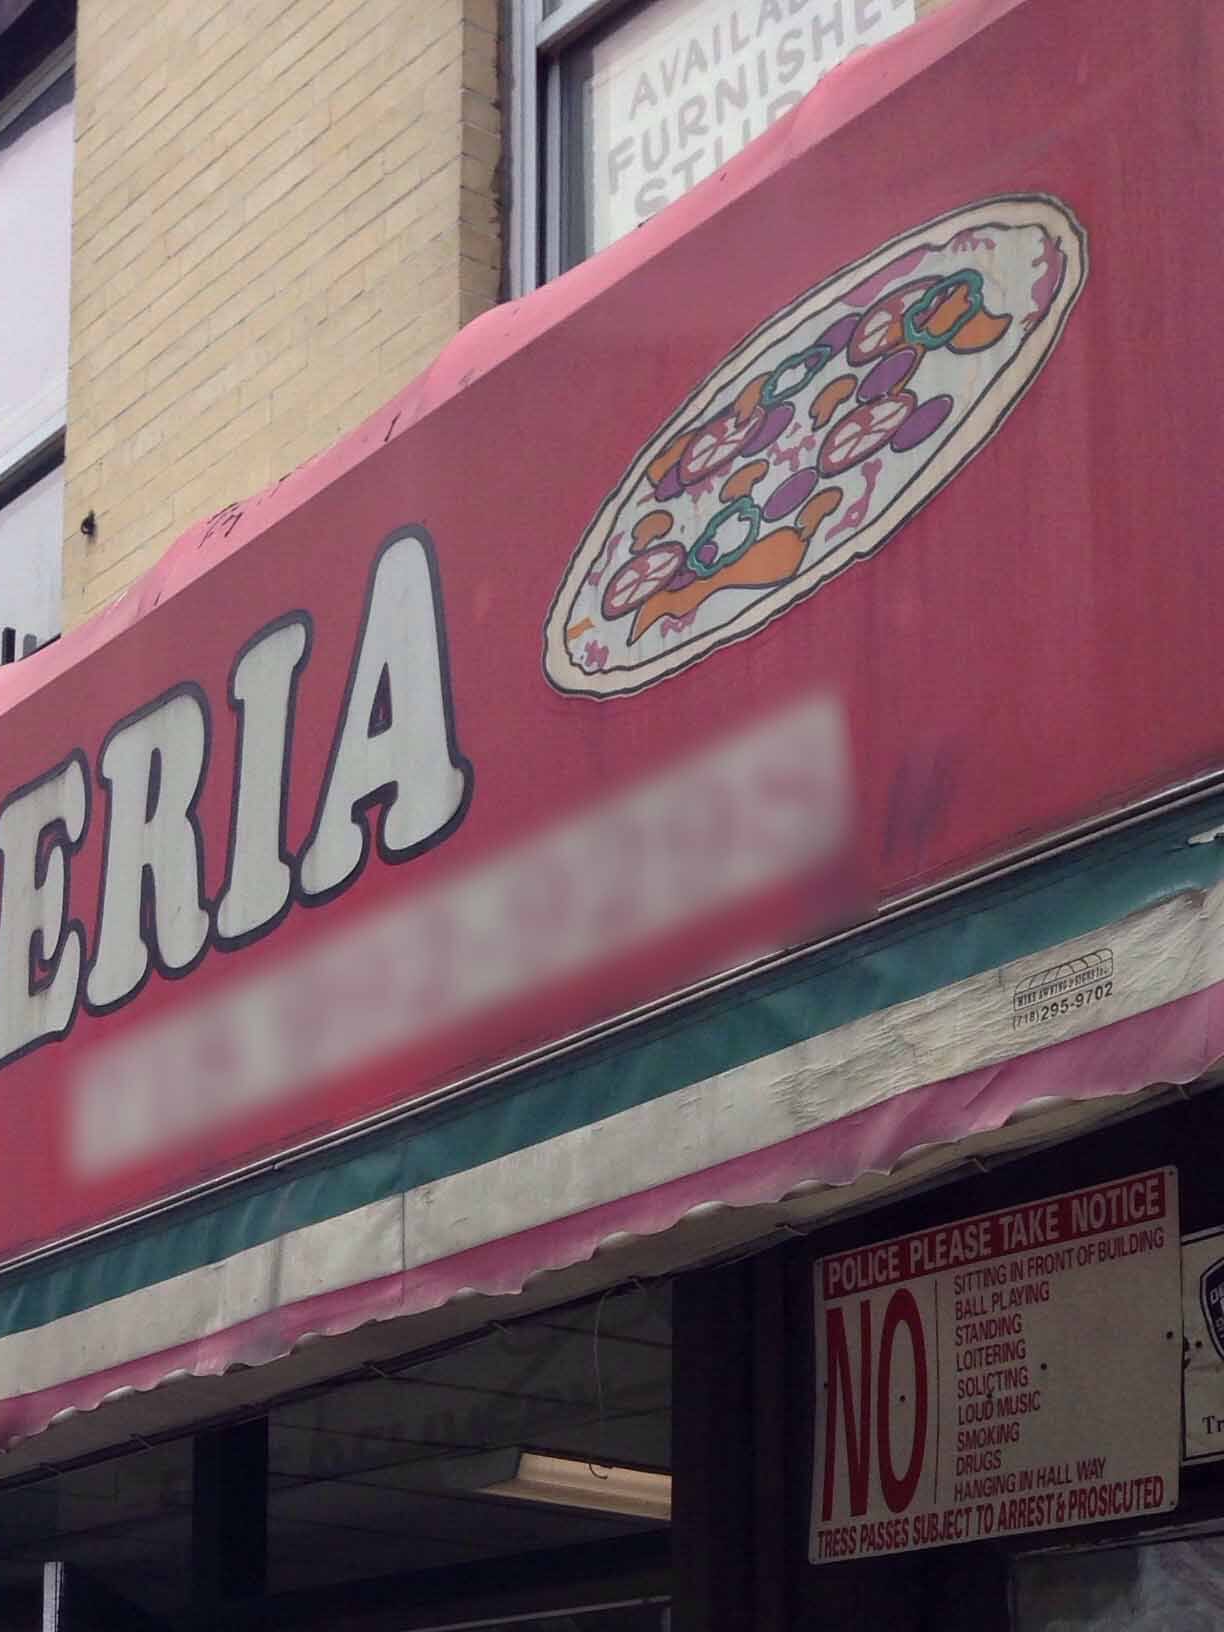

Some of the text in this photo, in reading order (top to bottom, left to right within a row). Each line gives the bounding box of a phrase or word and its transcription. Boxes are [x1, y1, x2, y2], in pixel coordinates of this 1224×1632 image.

[607, 0, 910, 195] FURNISHE
[828, 1177, 1161, 1296] POLICE PLEASE TAKE NOTICE
[954, 1226, 1164, 1296] SITTING IN FRONT OF BUILDING
[956, 1281, 1050, 1321] BALL PLAYING
[955, 1313, 1022, 1347] STANDING
[956, 1338, 1026, 1373] LOITERING
[957, 1366, 1029, 1400] SOLICTING
[821, 1286, 928, 1522] NO
[958, 1390, 1041, 1426] LOUD MUSIC
[956, 1422, 1020, 1452] SMOKING
[954, 1456, 1107, 1502] HANGING IN HALL WAY
[956, 1449, 1002, 1477] DRUGS
[816, 1525, 857, 1559] TRESS
[860, 1516, 910, 1554] PASSES
[912, 1506, 973, 1545] SUBJECT
[975, 1503, 994, 1537] TO
[997, 1495, 1056, 1531] ARREST
[1067, 1475, 1164, 1522] PROSICUTED
